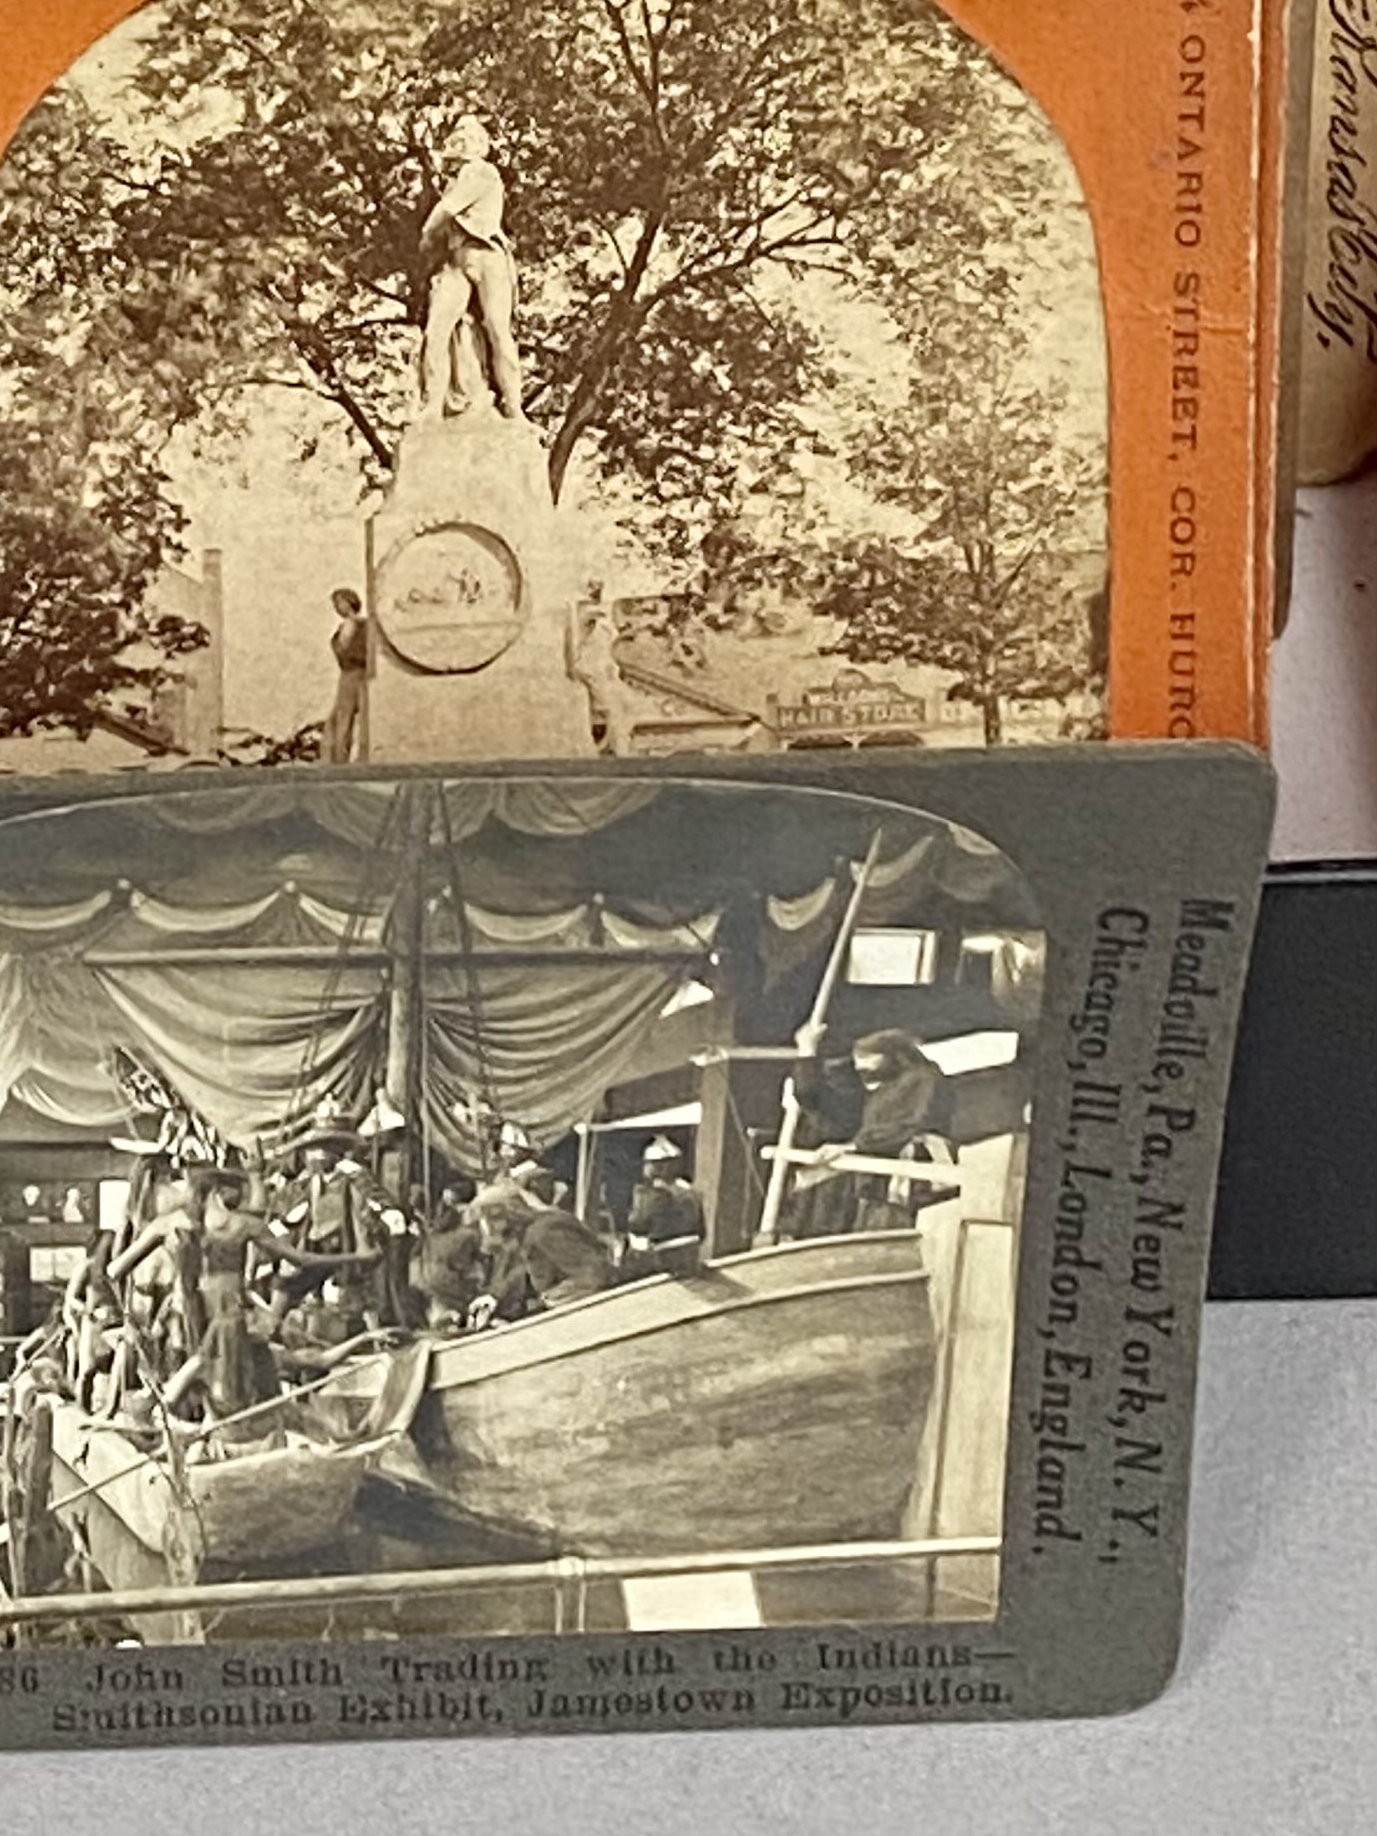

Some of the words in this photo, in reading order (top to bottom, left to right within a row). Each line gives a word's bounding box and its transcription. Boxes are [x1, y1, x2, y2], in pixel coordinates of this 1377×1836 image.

[1175, 34, 1206, 248] ONTARIO
[1167, 271, 1201, 462] STREET,
[1169, 486, 1196, 591] COR.
[1067, 905, 1150, 1071] Chicago,
[1140, 898, 1236, 1094] Meadville,
[1129, 1102, 1196, 1185] Pa.,
[1037, 1158, 1113, 1339] London,
[1129, 1194, 1186, 1294] New
[1106, 1305, 1176, 1428] York,
[1028, 1347, 1093, 1555] England.
[52, 1695, 317, 1732] Smithsonian
[338, 1689, 504, 1724] Exhibit,
[526, 1684, 757, 1718] Jamestown
[779, 1676, 1014, 1719] Exposition.
[85, 1663, 184, 1694] John
[221, 1657, 343, 1688] Smith
[379, 1650, 549, 1684] Trading
[585, 1646, 675, 1677] with
[713, 1645, 777, 1672] the
